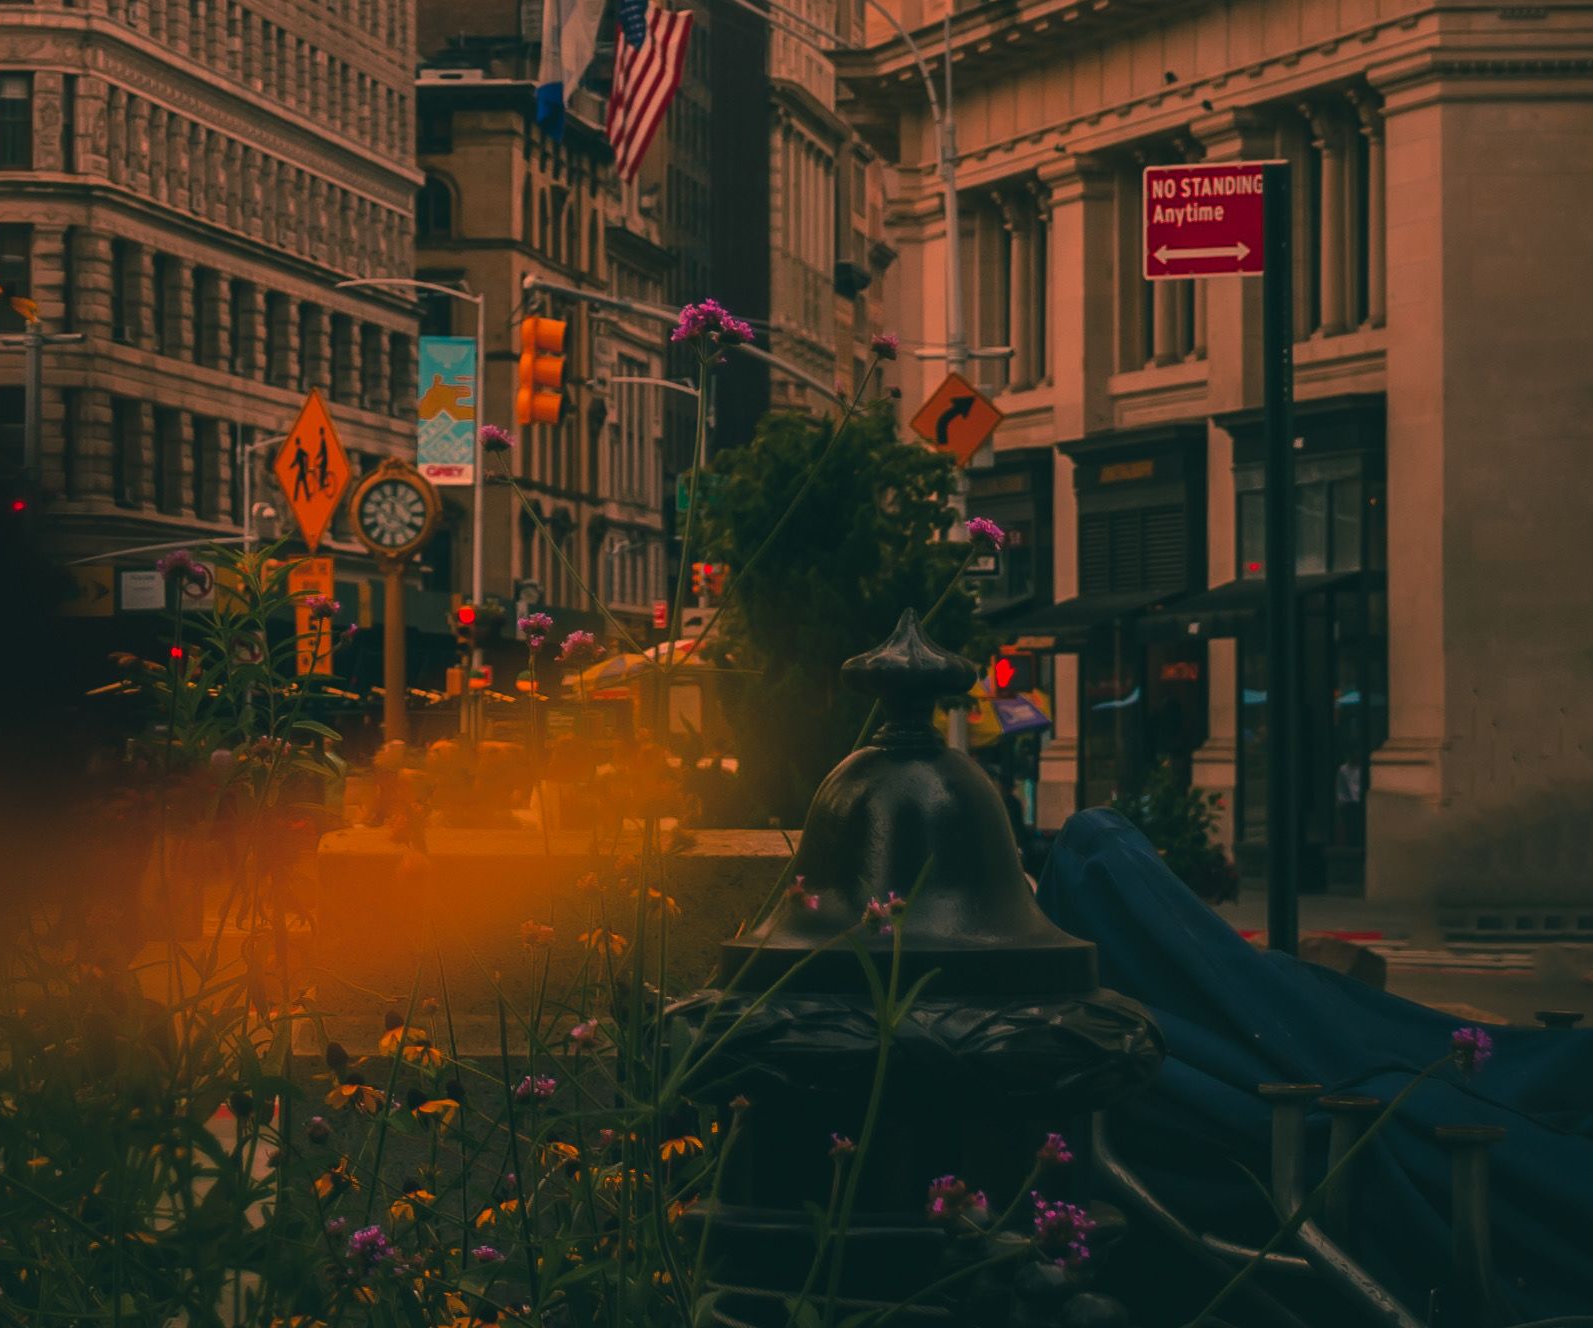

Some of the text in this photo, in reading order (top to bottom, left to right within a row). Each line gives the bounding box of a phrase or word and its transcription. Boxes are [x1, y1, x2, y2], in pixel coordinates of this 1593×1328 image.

[1152, 174, 1263, 199] NO STANDING
[1153, 203, 1224, 227] Anytime
